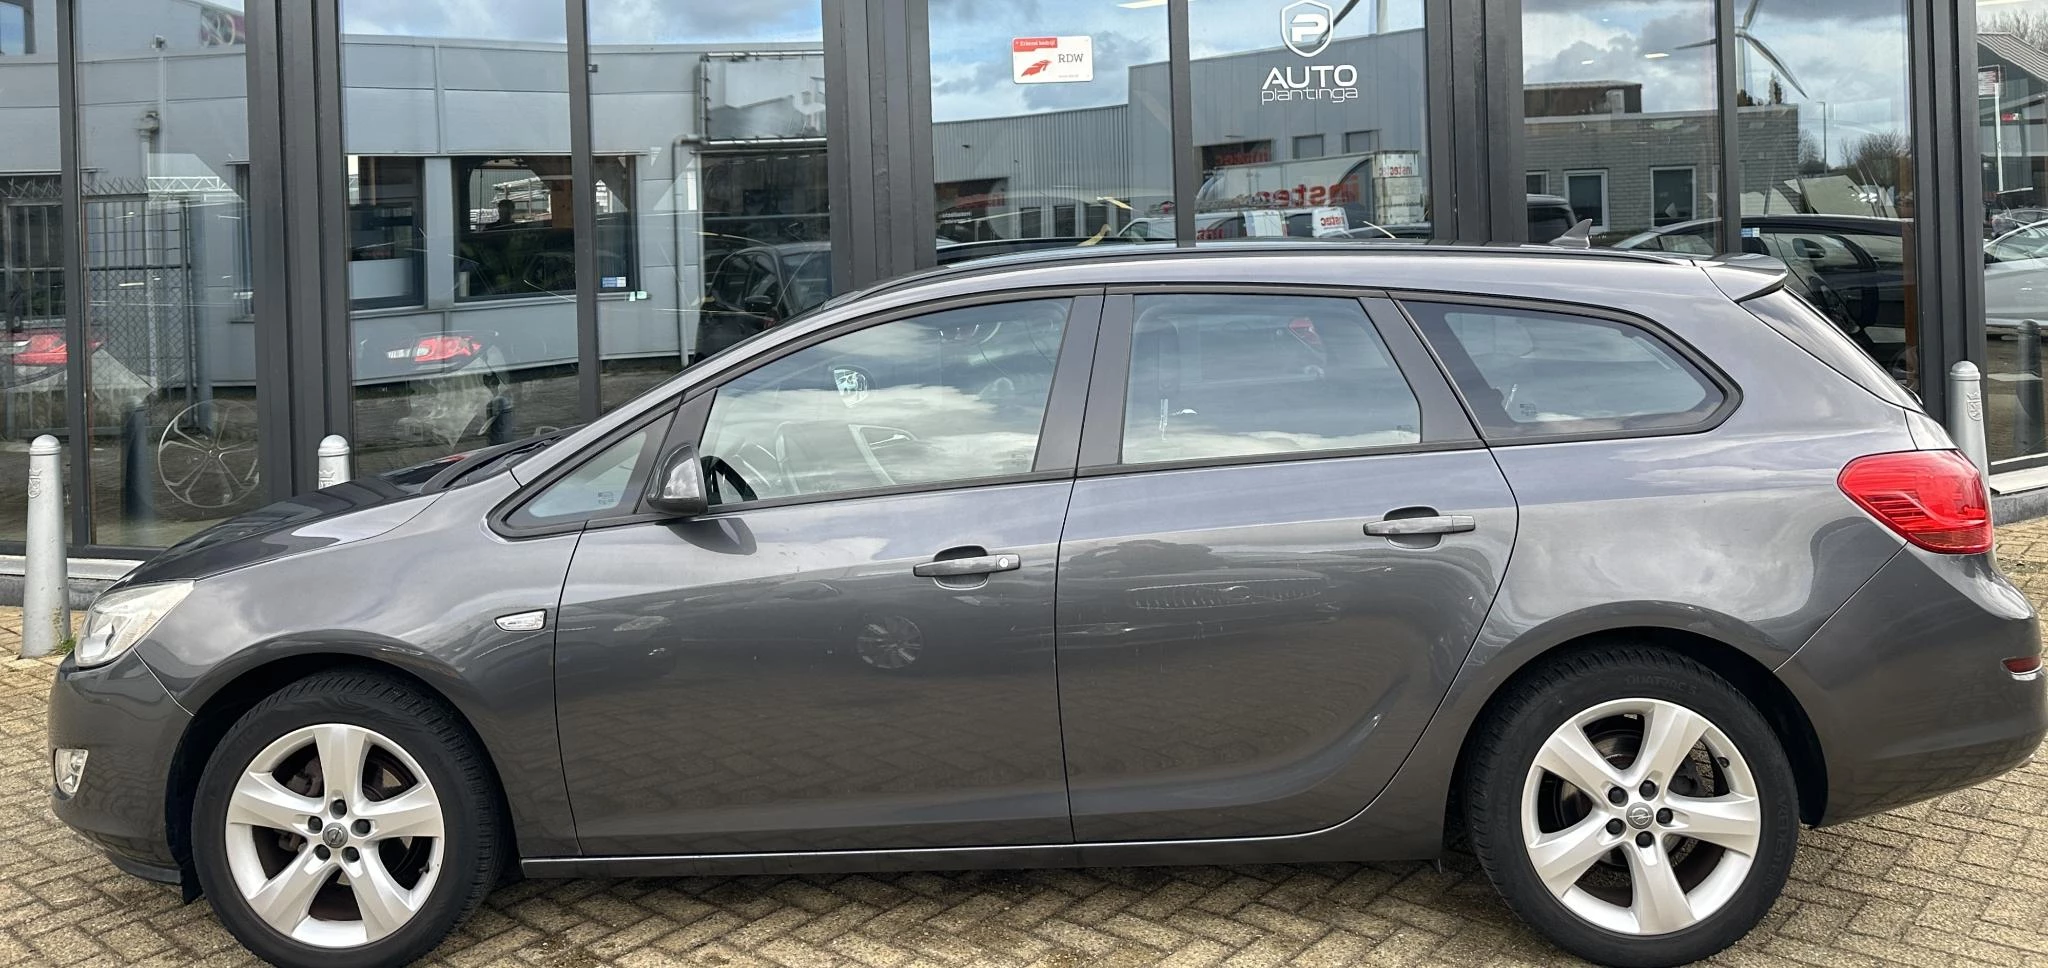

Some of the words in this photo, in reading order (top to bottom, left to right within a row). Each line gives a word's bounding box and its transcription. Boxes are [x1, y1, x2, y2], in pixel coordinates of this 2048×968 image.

[1291, 13, 1328, 42] P
[1058, 53, 1084, 63] RDW
[1262, 64, 1358, 90] AUTO
[1262, 87, 1358, 105] plantinga
